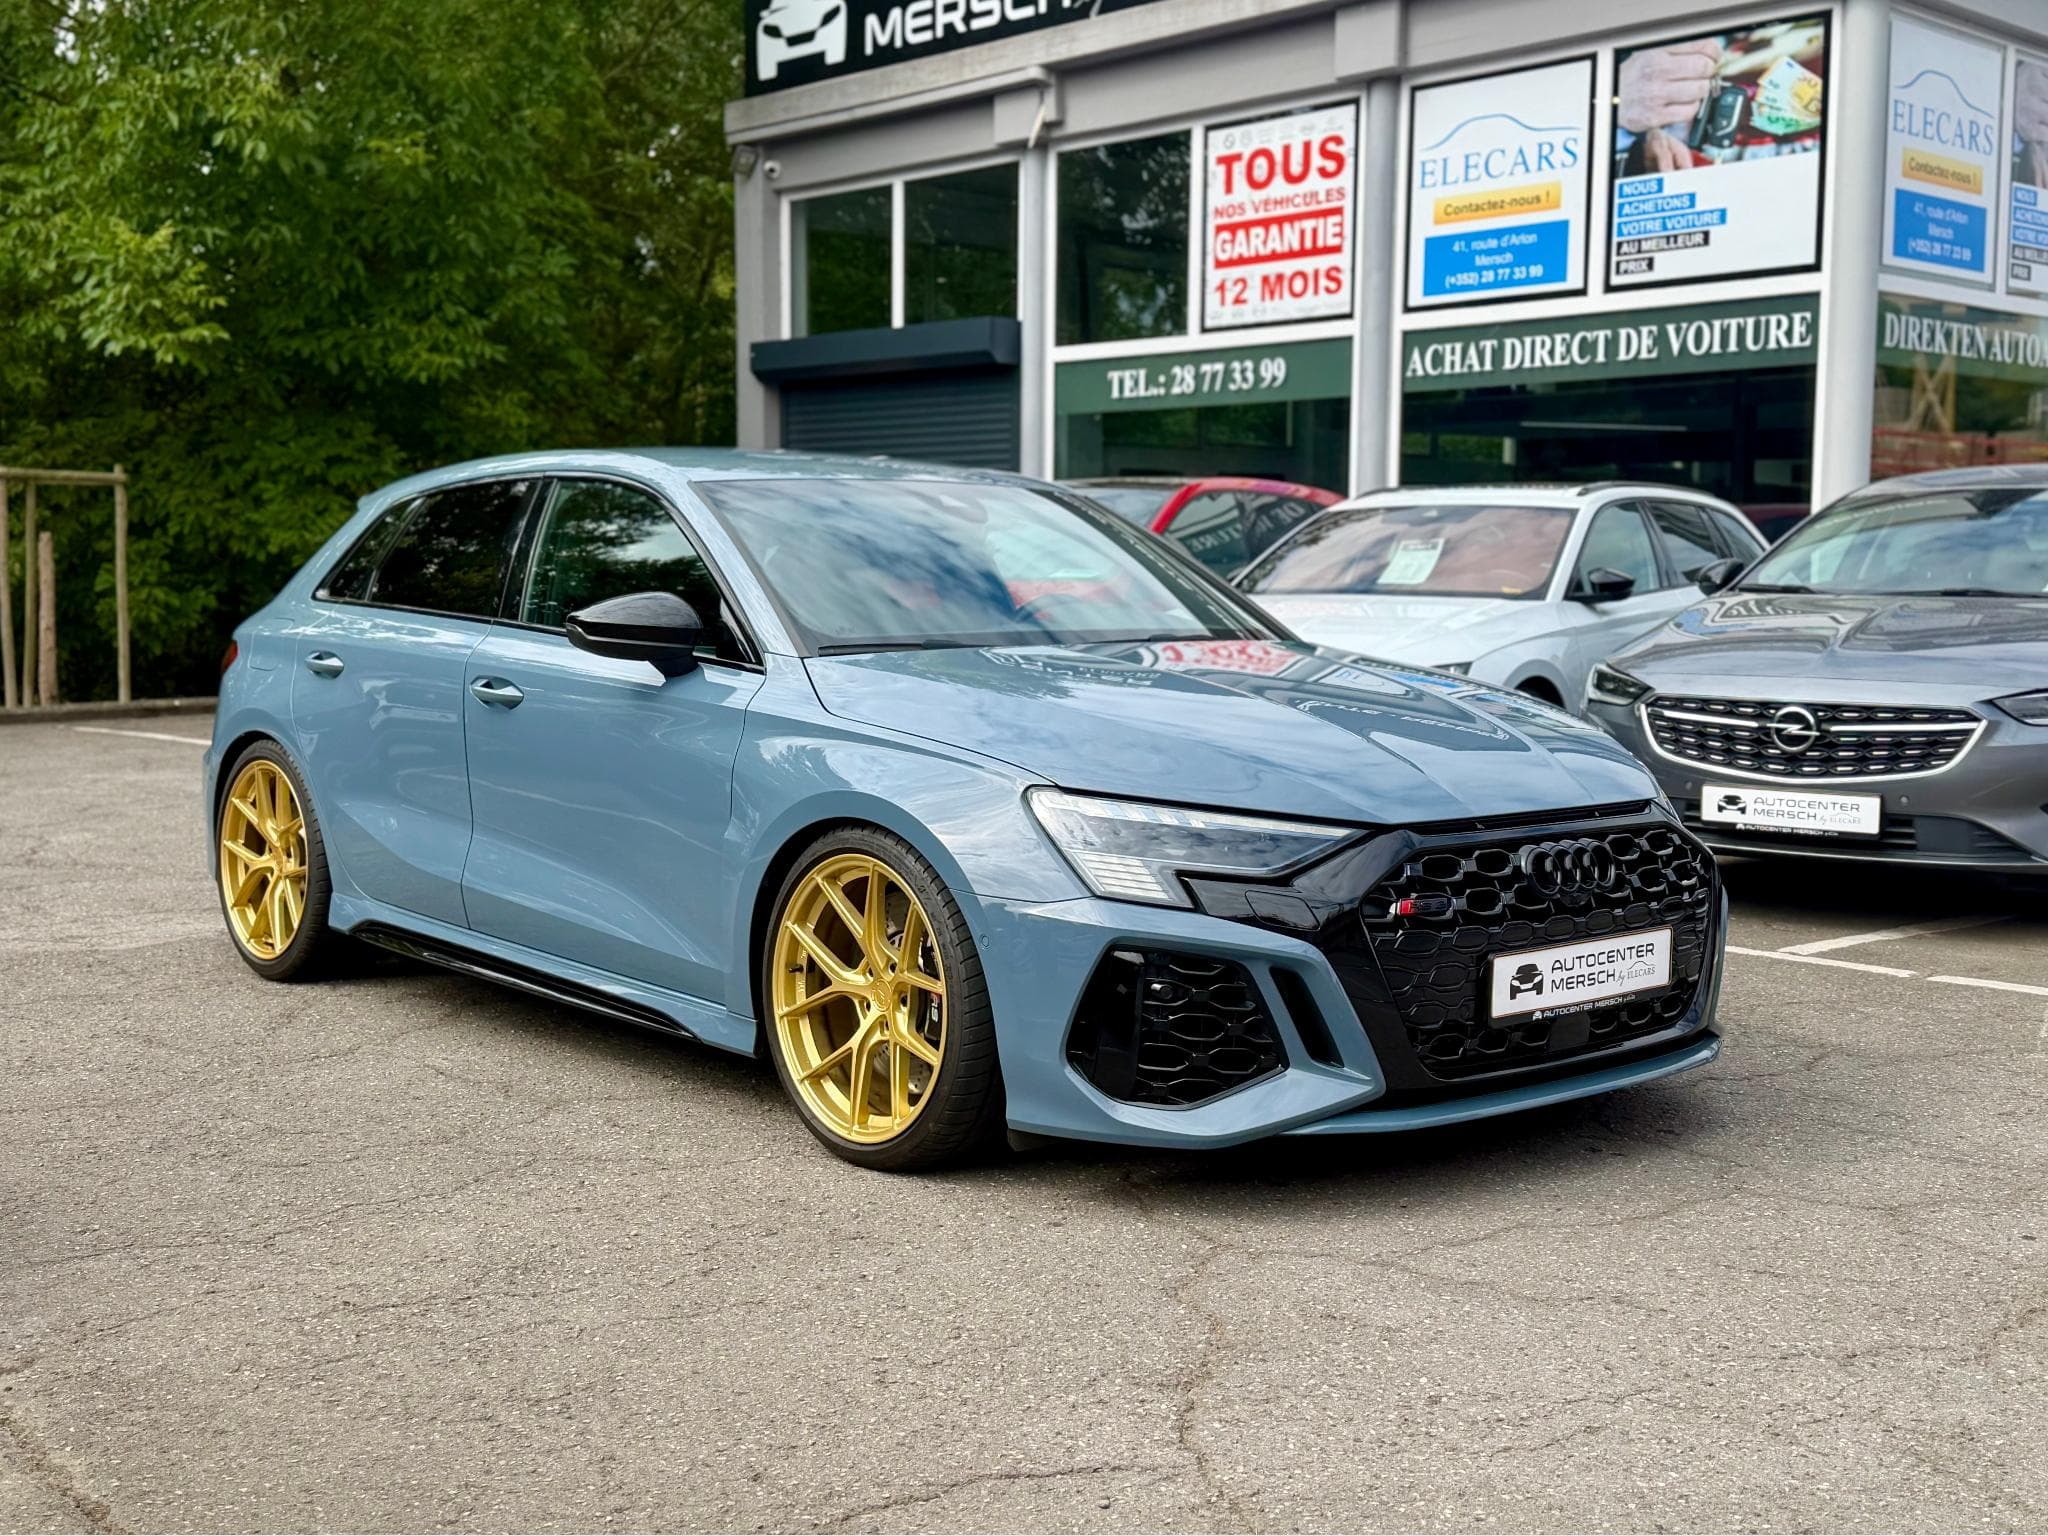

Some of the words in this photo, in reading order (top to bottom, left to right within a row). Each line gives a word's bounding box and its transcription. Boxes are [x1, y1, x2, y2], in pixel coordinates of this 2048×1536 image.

[864, 0, 1071, 55] MERSC
[1893, 99, 1994, 156] ELECARS
[1216, 135, 1346, 195] TOUS
[1419, 137, 1578, 189] ELECARS
[1622, 180, 1658, 196] NOUS
[1214, 204, 1246, 220] NOS
[1443, 193, 1541, 217] Contactez-nous
[1622, 195, 1690, 215] ACHETONS
[1621, 219, 1663, 235] VOTRE
[1665, 211, 1721, 230] VOITURE
[1216, 214, 1342, 262] GARANTIE
[1471, 238, 1498, 251] route
[1620, 241, 1638, 255] AU
[1640, 232, 1704, 252] MEILLEUR
[1475, 252, 1514, 267] Mersch
[1620, 260, 1648, 274] PRIX
[1481, 270, 1494, 283] 28
[1497, 268, 1511, 281] 77
[1512, 265, 1526, 280] 33
[1529, 264, 1543, 278] 99
[1216, 277, 1248, 307] 12
[1261, 266, 1342, 303] MOIS
[1406, 338, 1498, 378] ACHAT
[1502, 328, 1611, 371] DIRECT
[1617, 325, 1659, 362] DE
[1664, 312, 1812, 358] VOITURE
[1884, 312, 1987, 361] DIREKTEN
[1107, 367, 1166, 400] TEL.:
[1170, 364, 1195, 395] 28
[1200, 361, 1225, 393] 77
[1228, 359, 1254, 392] 33
[1259, 357, 1287, 389] 99
[1753, 796, 1861, 812] AUTOCENTER
[1753, 808, 1817, 821] MERSCH
[1551, 943, 1655, 974] AUTOCENTER
[1551, 968, 1616, 993] MERSCH
[1627, 966, 1656, 980] ELECARS
[1543, 1002, 1593, 1018] AUTOCENTER
[1594, 996, 1623, 1009] MERSCH
